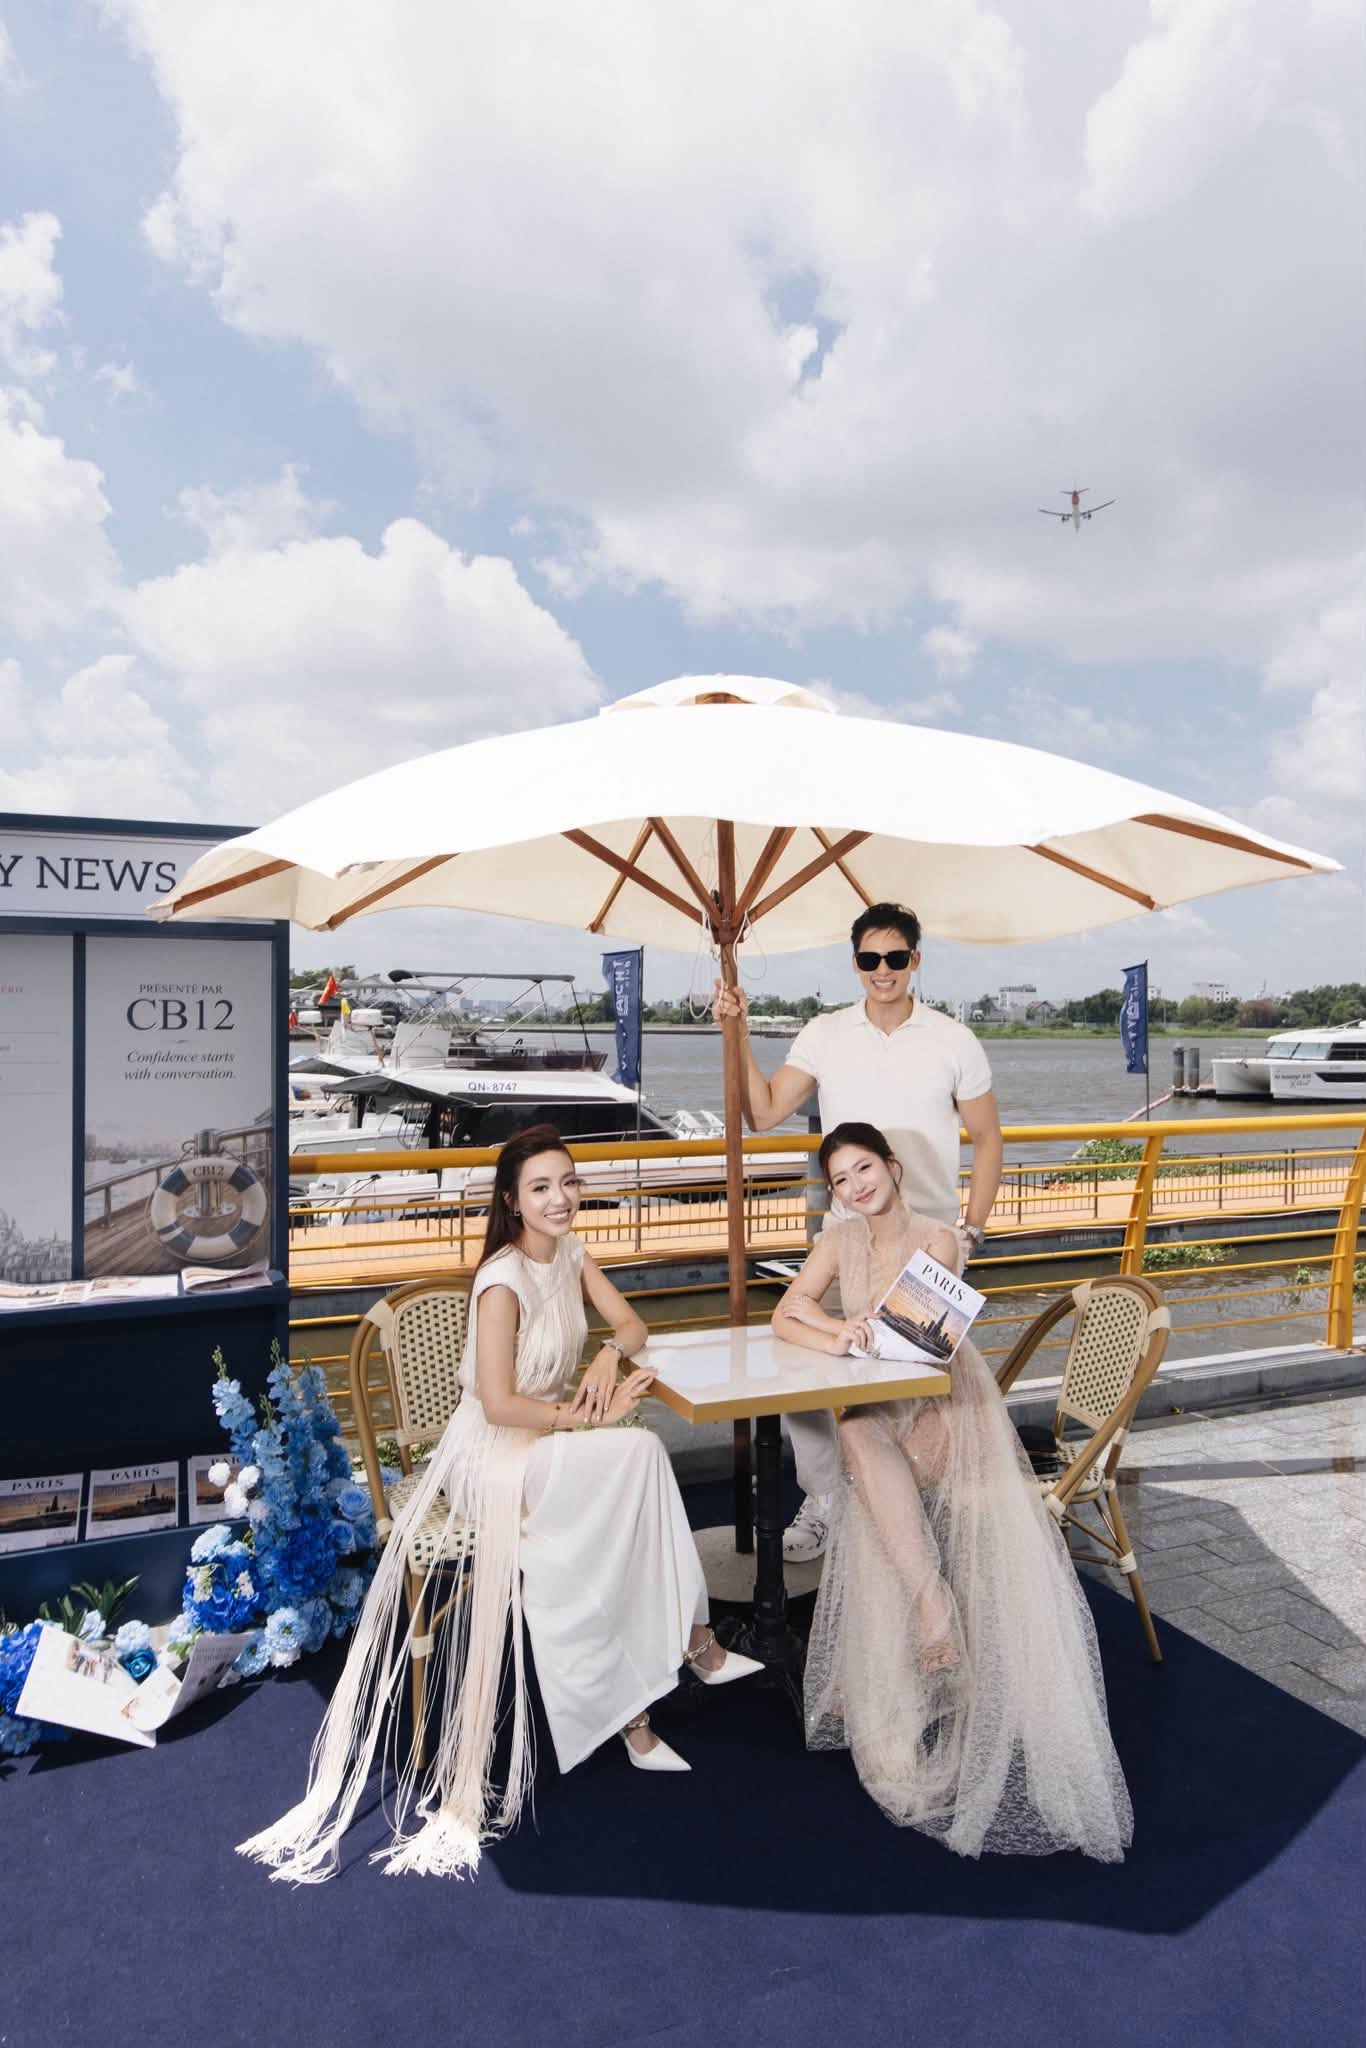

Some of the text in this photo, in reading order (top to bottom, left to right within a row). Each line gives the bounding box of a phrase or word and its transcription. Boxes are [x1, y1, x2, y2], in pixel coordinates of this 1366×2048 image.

[36, 856, 176, 893] NEWS
[201, 984, 223, 994] PAR
[127, 998, 235, 1030] CB12
[127, 1050, 235, 1065] Confidence starts
[124, 1068, 151, 1080] with
[921, 1263, 966, 1302] PARIS
[111, 1467, 160, 1481] PARIS
[12, 1479, 64, 1491] PARIS
